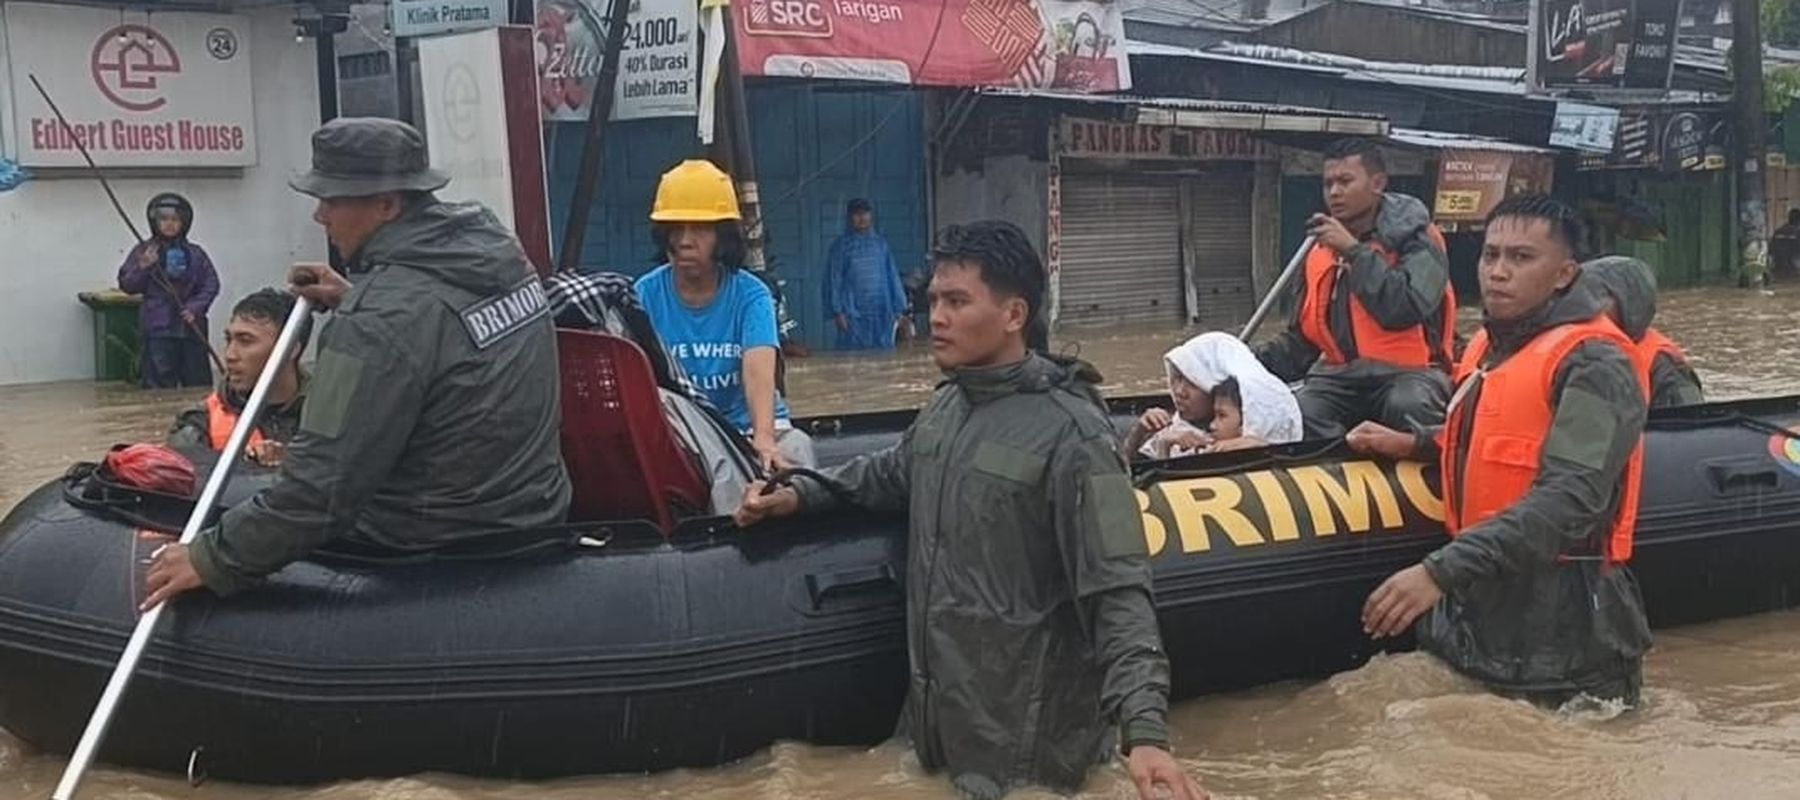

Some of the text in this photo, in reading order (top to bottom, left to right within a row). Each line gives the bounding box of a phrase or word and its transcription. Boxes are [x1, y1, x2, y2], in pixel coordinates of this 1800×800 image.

[406, 5, 490, 24] Klinik Pratama
[771, 0, 902, 26] SRC Tarigan
[213, 36, 231, 52] 24
[620, 17, 677, 50] 24.000
[626, 52, 688, 74] 40% Durasi
[623, 79, 651, 99] Lebih
[111, 119, 176, 150] Guest
[178, 120, 244, 151] House
